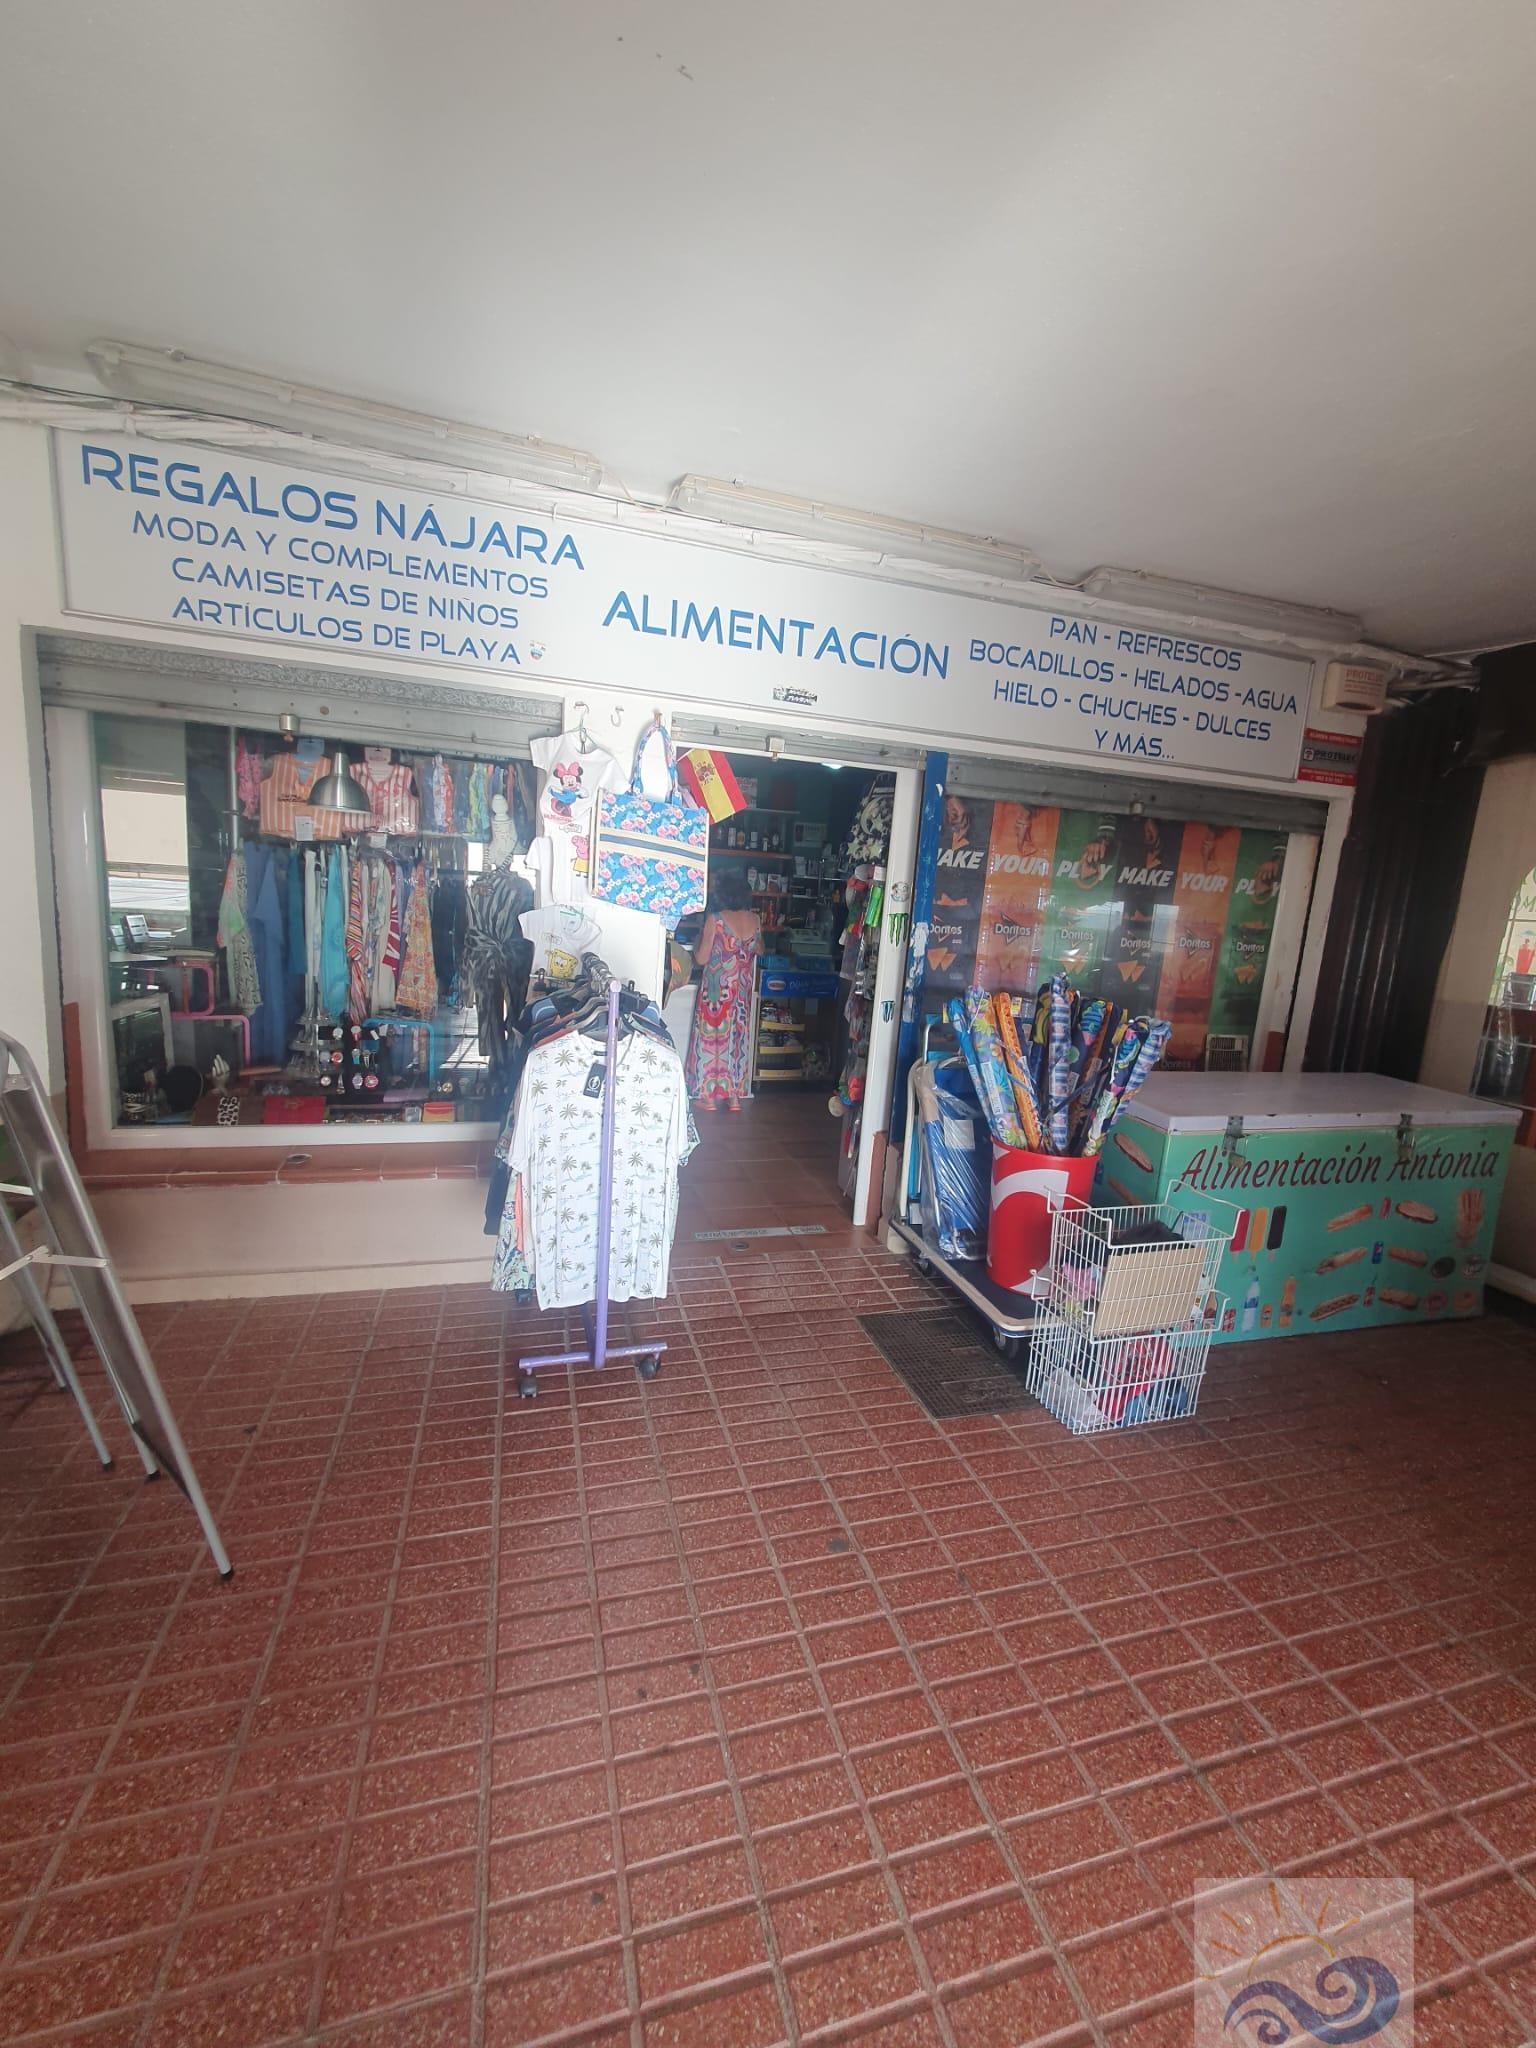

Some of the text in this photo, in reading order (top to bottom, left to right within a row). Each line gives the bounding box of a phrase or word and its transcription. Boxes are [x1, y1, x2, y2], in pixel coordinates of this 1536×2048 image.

[82, 444, 585, 570] REGALOS NÁJARA
[133, 510, 549, 598] MODA Y COMPLEMENTOS
[172, 557, 519, 629] CAMISETAS DE NIÑOS
[172, 597, 521, 665] ARTÍCULOS DE PLAYA
[602, 590, 949, 680] ALIMENTACIÓN
[1049, 617, 1098, 646] PAN
[1117, 630, 1242, 671] REFRESCOS
[969, 639, 1115, 684] BOCADILLOS
[1134, 669, 1230, 702] HELADOS
[994, 680, 1058, 708] HIELO
[1079, 693, 1177, 726] CHUCHES
[1196, 711, 1271, 741] DULCES
[1094, 730, 1109, 749] Y
[937, 848, 984, 869] AKE
[993, 854, 1049, 877] YOUR
[1118, 866, 1174, 887] MAKE
[1180, 872, 1229, 893] YOUR
[995, 922, 1031, 936] Doritos
[1061, 929, 1094, 941] Doritos
[1120, 937, 1151, 949] Doritos
[1179, 937, 1211, 949] Doritos
[1236, 942, 1265, 953] Doritos
[1173, 1142, 1381, 1192] Alimentación
